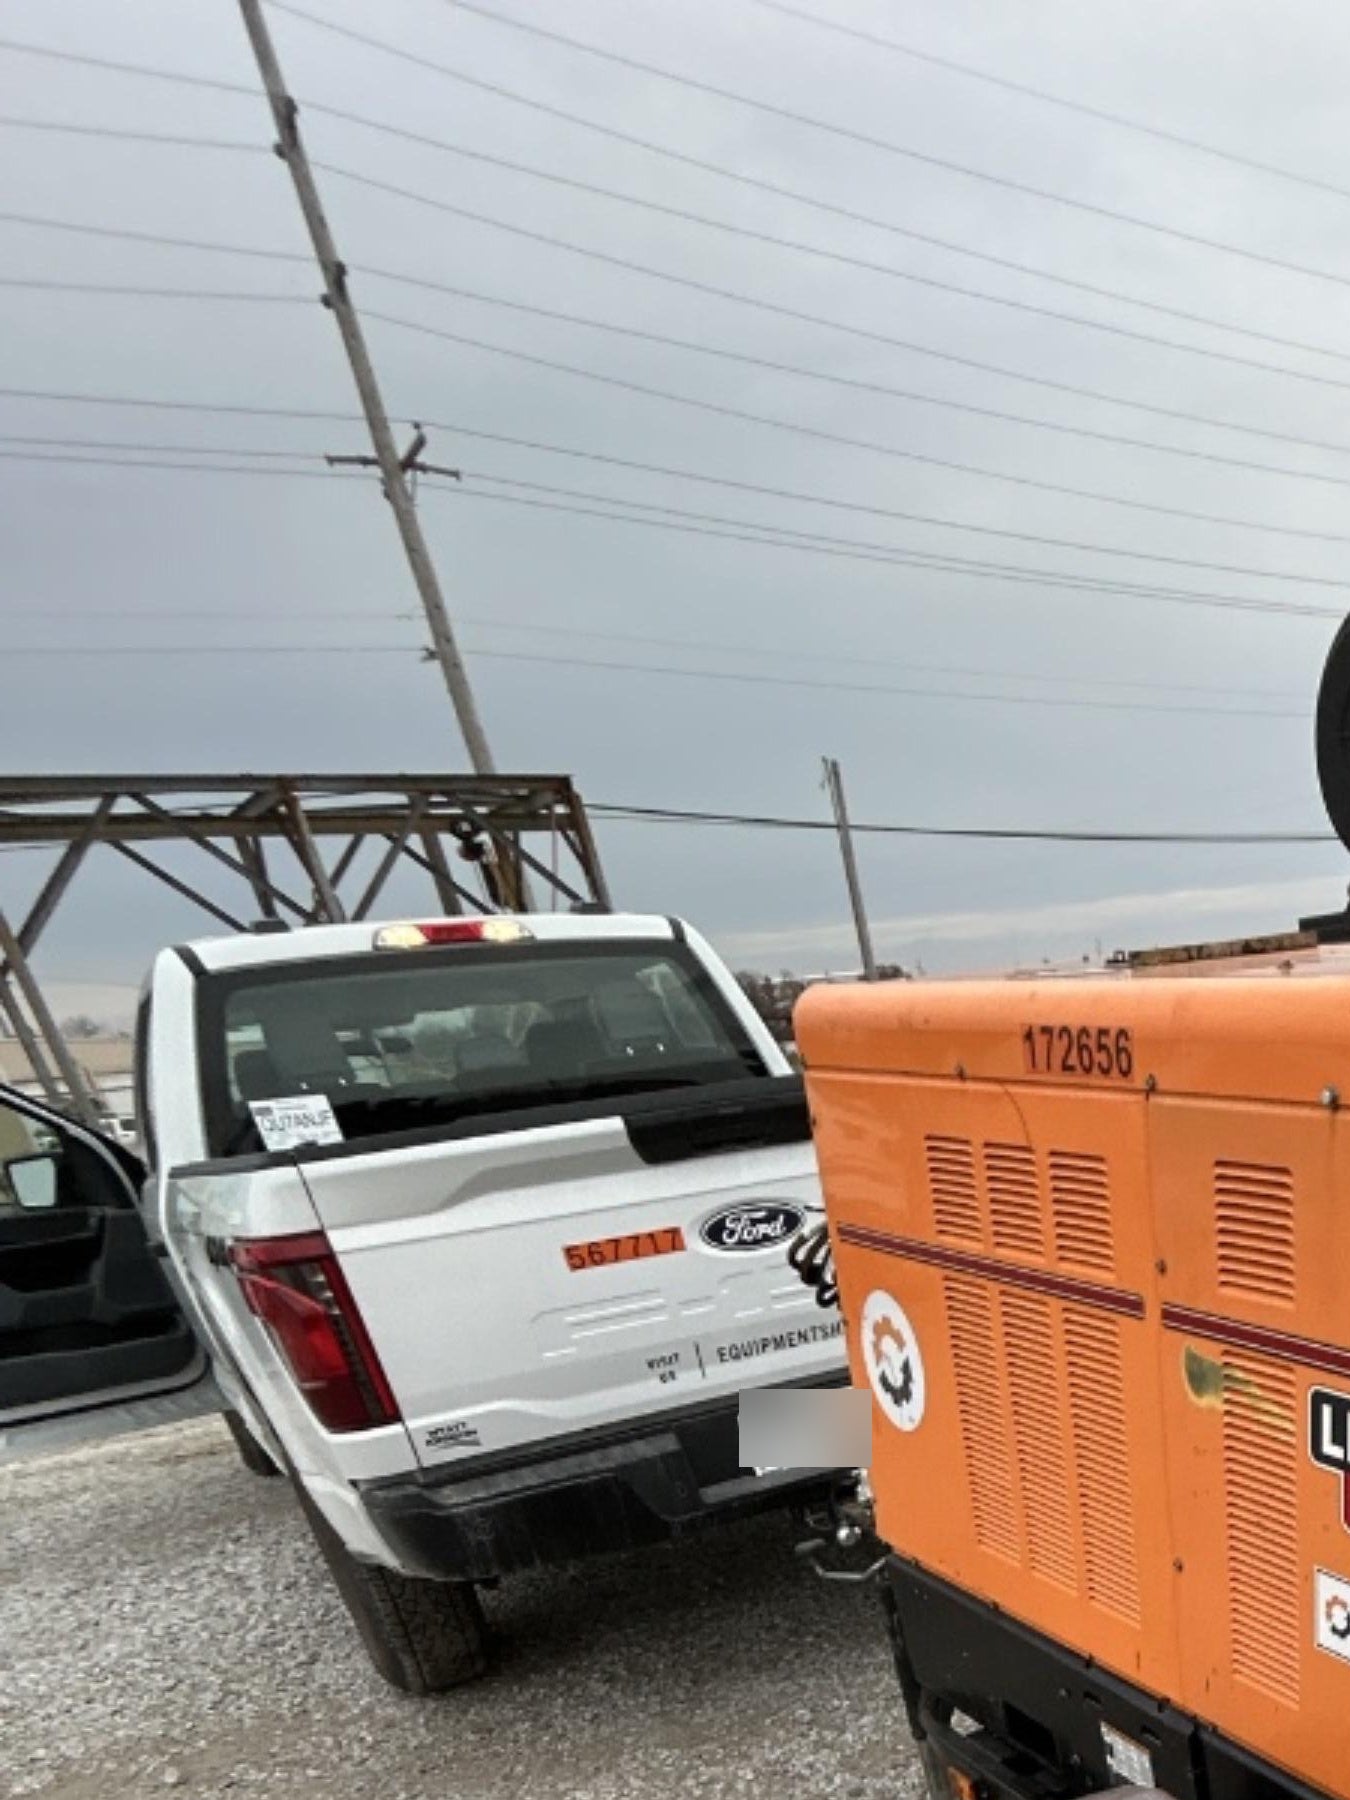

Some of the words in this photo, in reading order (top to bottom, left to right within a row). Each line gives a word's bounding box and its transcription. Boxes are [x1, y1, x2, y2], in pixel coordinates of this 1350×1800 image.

[1023, 1025, 1132, 1077] 172656
[722, 1209, 787, 1245] Ford
[566, 1229, 679, 1269] 567717
